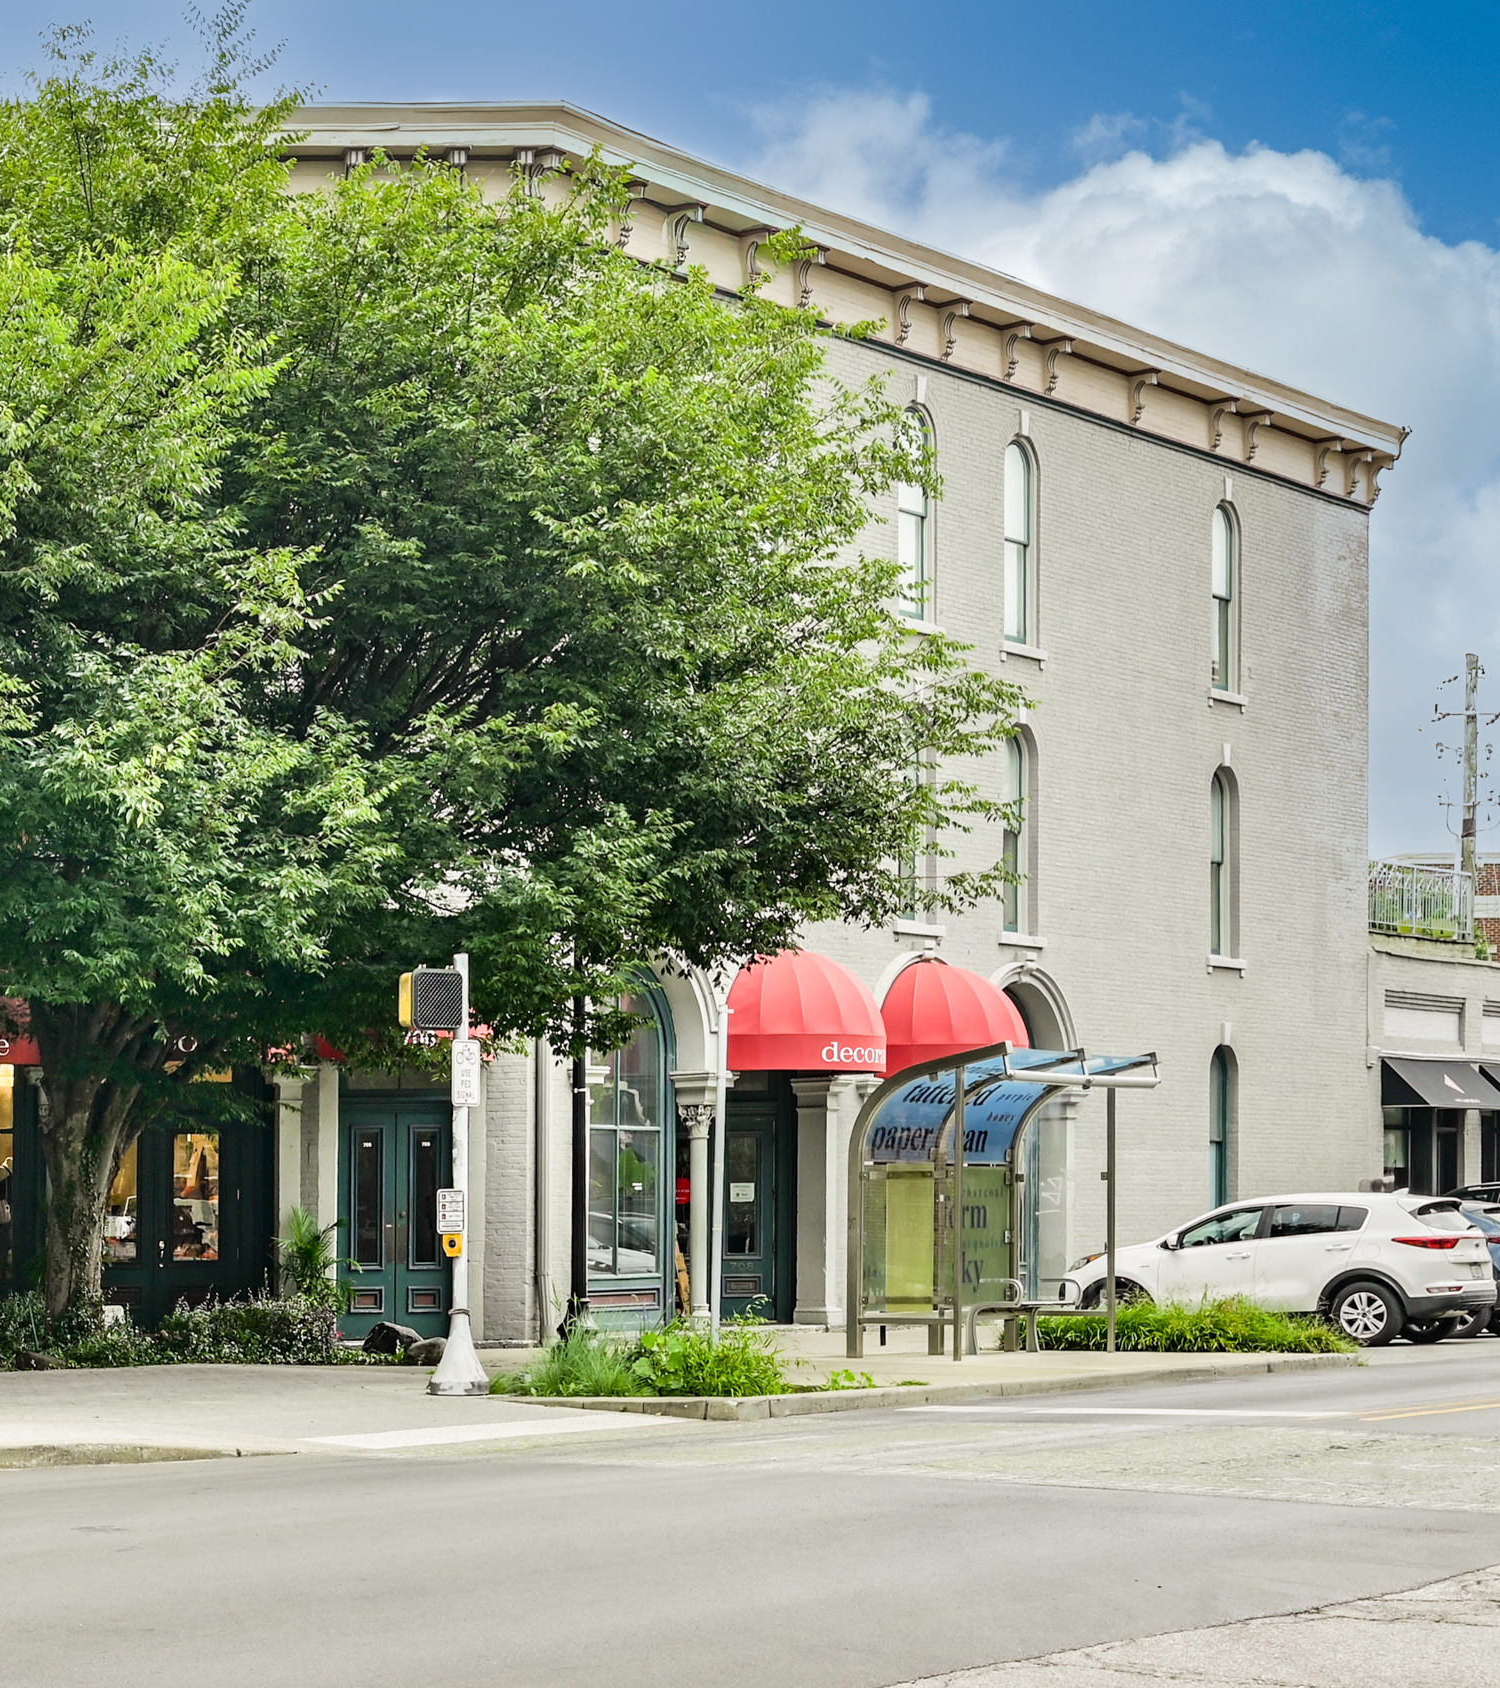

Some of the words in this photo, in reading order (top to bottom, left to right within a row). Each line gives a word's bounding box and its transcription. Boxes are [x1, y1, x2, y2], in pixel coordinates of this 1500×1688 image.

[903, 1082, 1003, 1107] tatted
[995, 1093, 1034, 1103] purple
[986, 1111, 1017, 1123] honey
[871, 1125, 934, 1153] paper
[729, 1261, 755, 1272] 708
